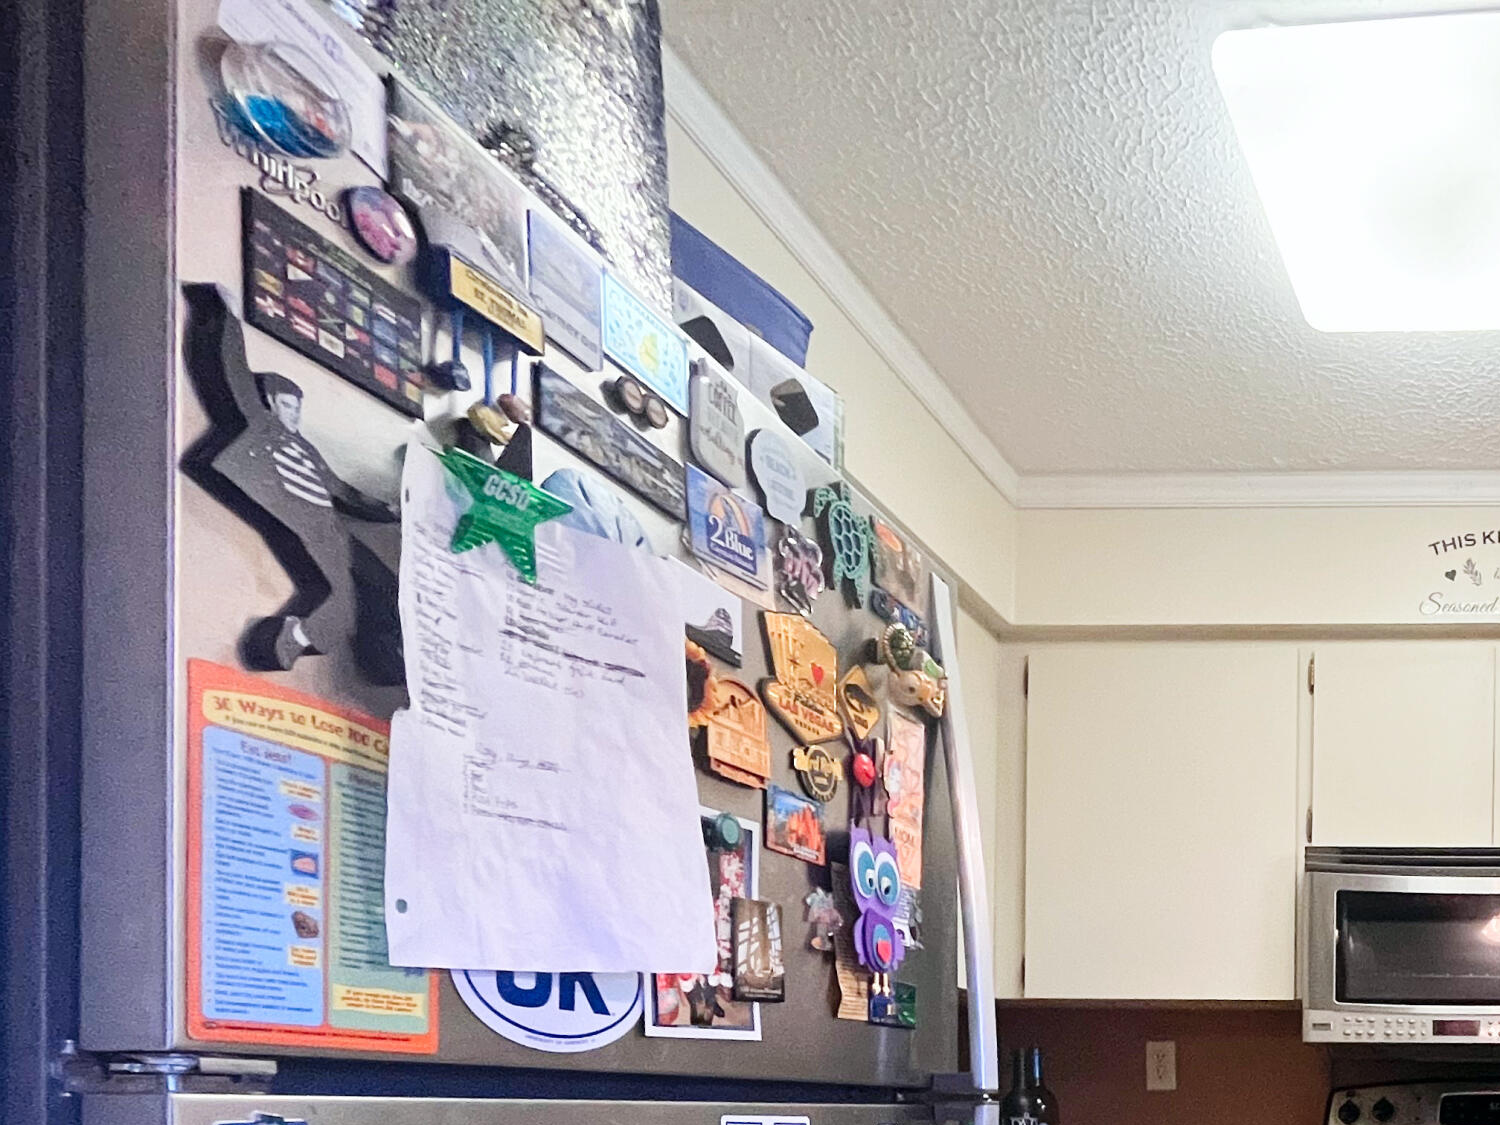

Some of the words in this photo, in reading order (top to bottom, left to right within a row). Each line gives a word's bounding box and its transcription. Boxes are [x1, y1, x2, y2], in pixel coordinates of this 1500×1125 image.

[1428, 533, 1477, 556] THIS
[1419, 592, 1500, 616] Seasoned
[237, 698, 285, 722] Ways
[289, 711, 307, 726] to
[311, 714, 345, 738] Lose
